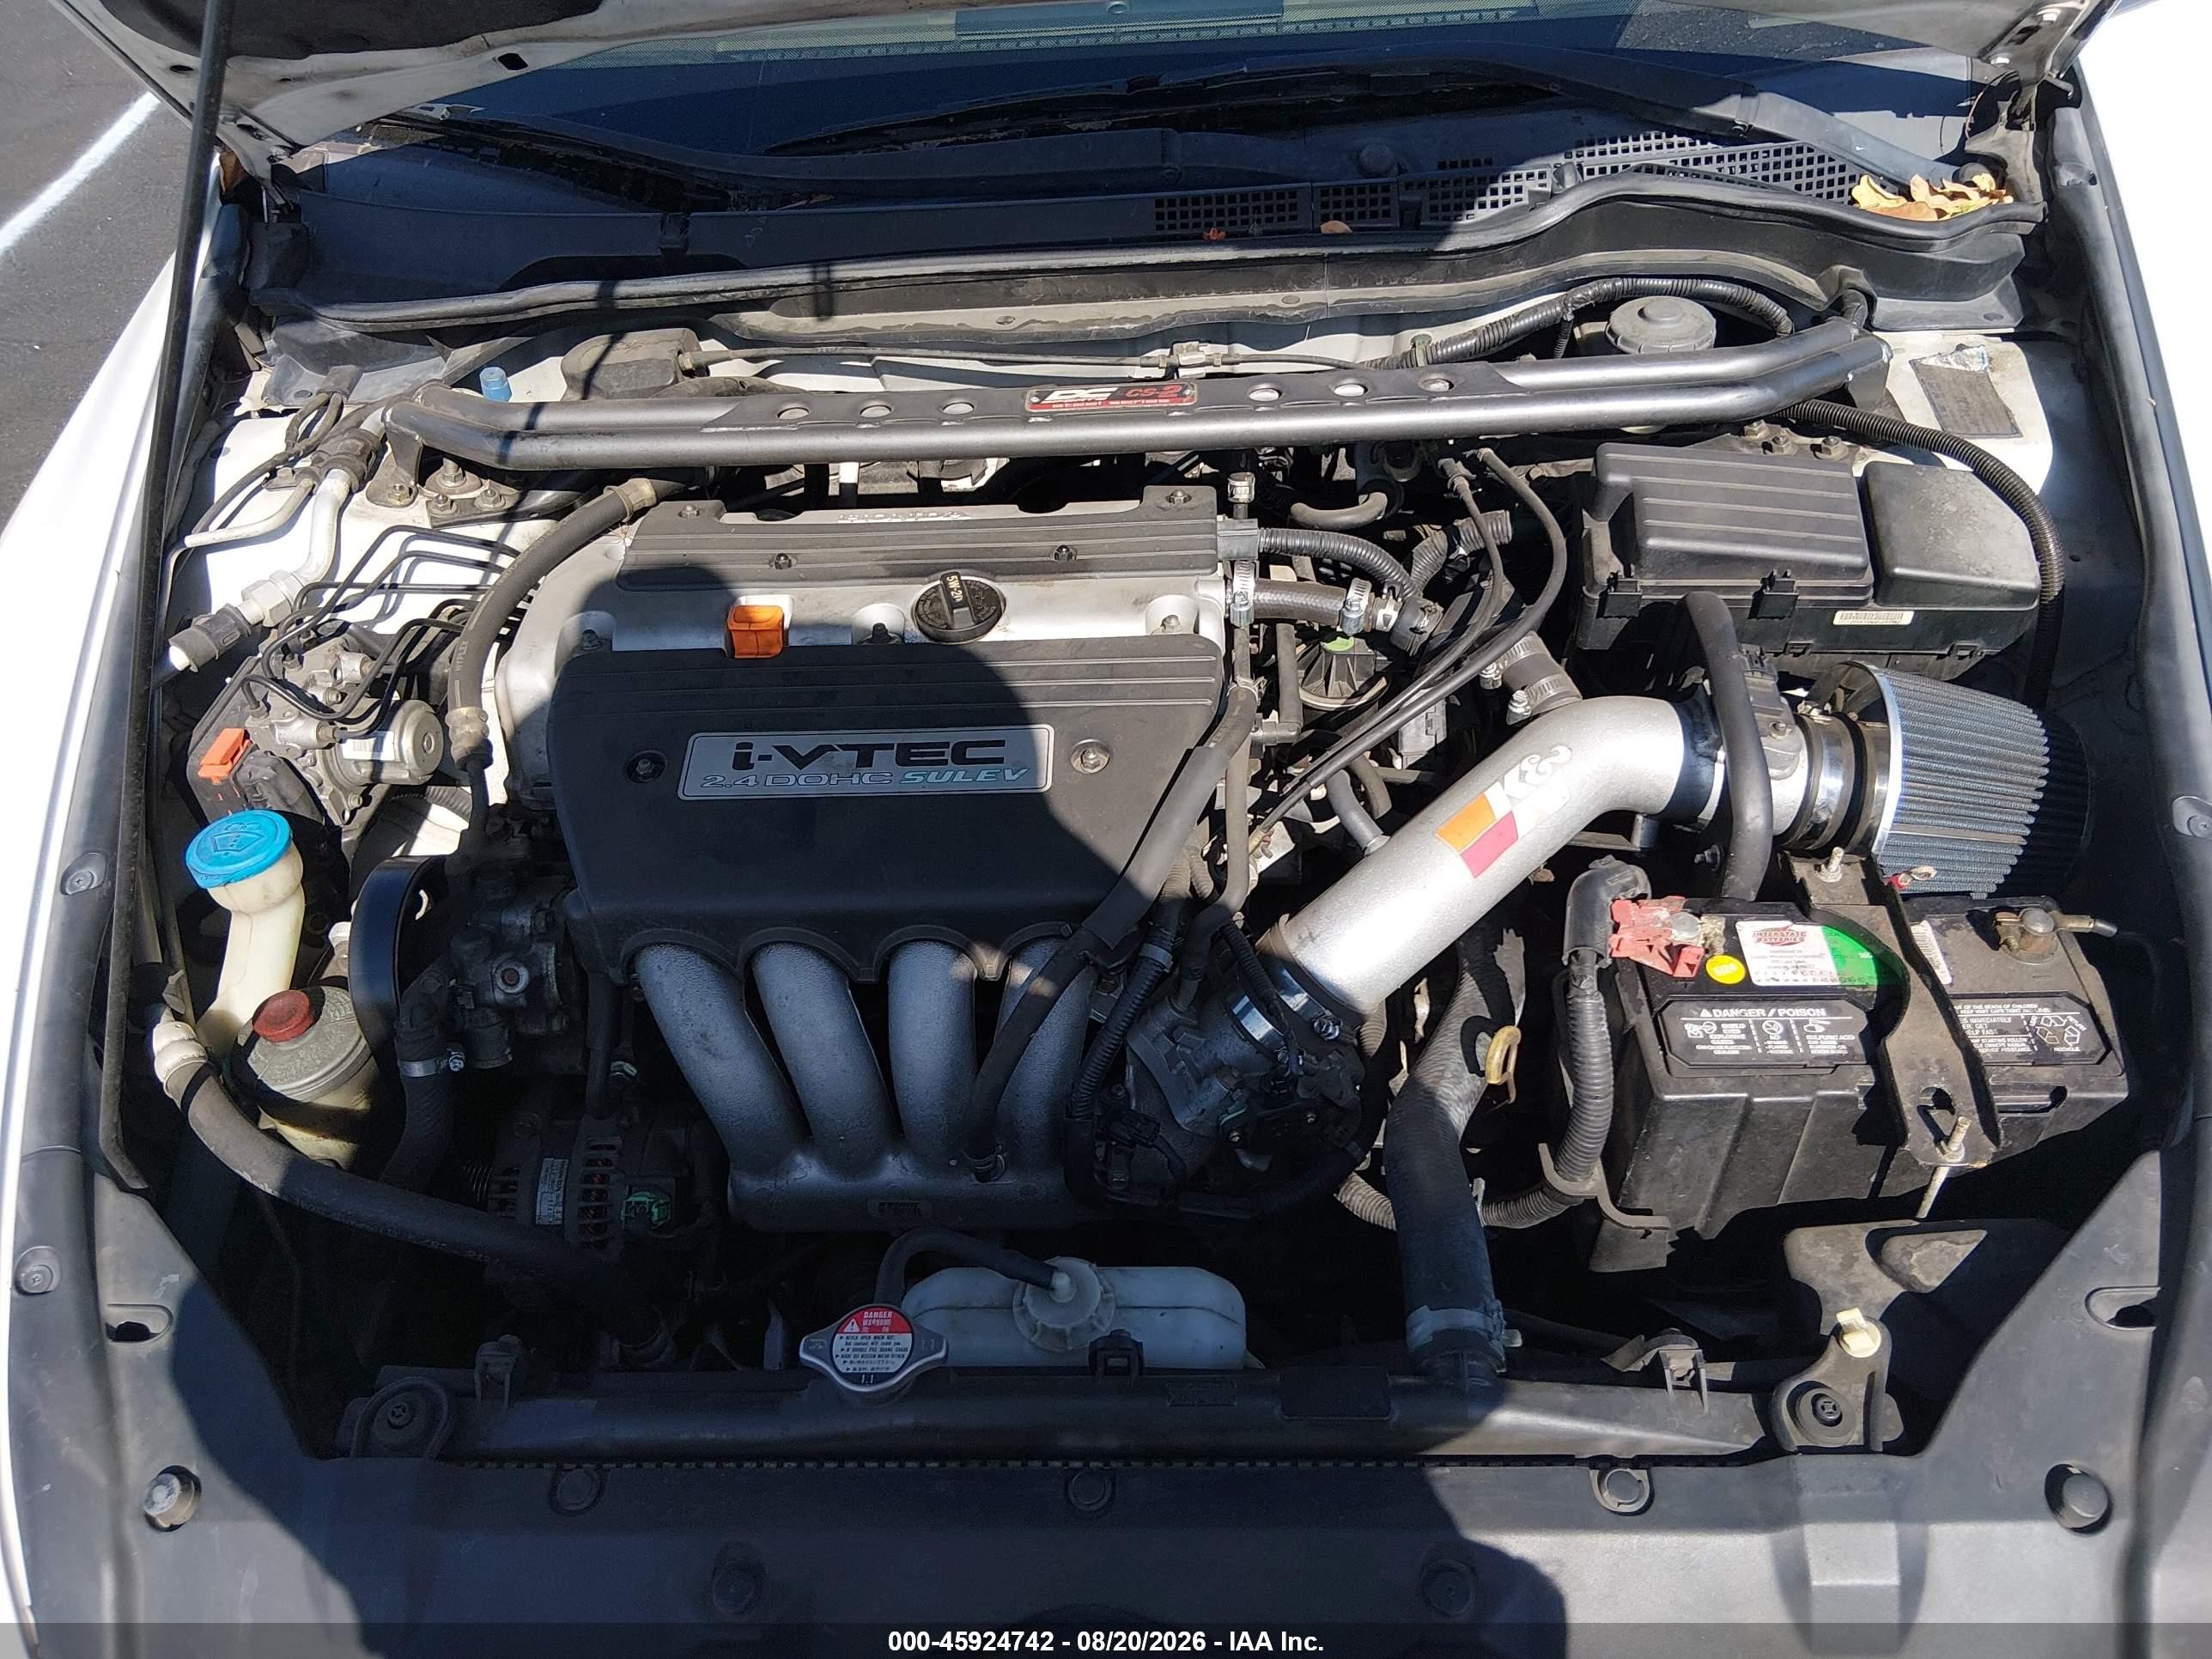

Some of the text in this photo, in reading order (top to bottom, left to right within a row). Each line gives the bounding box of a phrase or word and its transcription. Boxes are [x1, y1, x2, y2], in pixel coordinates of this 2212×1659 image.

[1125, 384, 1182, 398] CS-2
[945, 574, 964, 603] 5W-20
[732, 739, 1006, 771] i-VTEC
[701, 768, 1030, 788] 2.4 DOHC SULEV
[1711, 1008, 1765, 1018] DANGER
[1778, 1008, 1826, 1017] POISON
